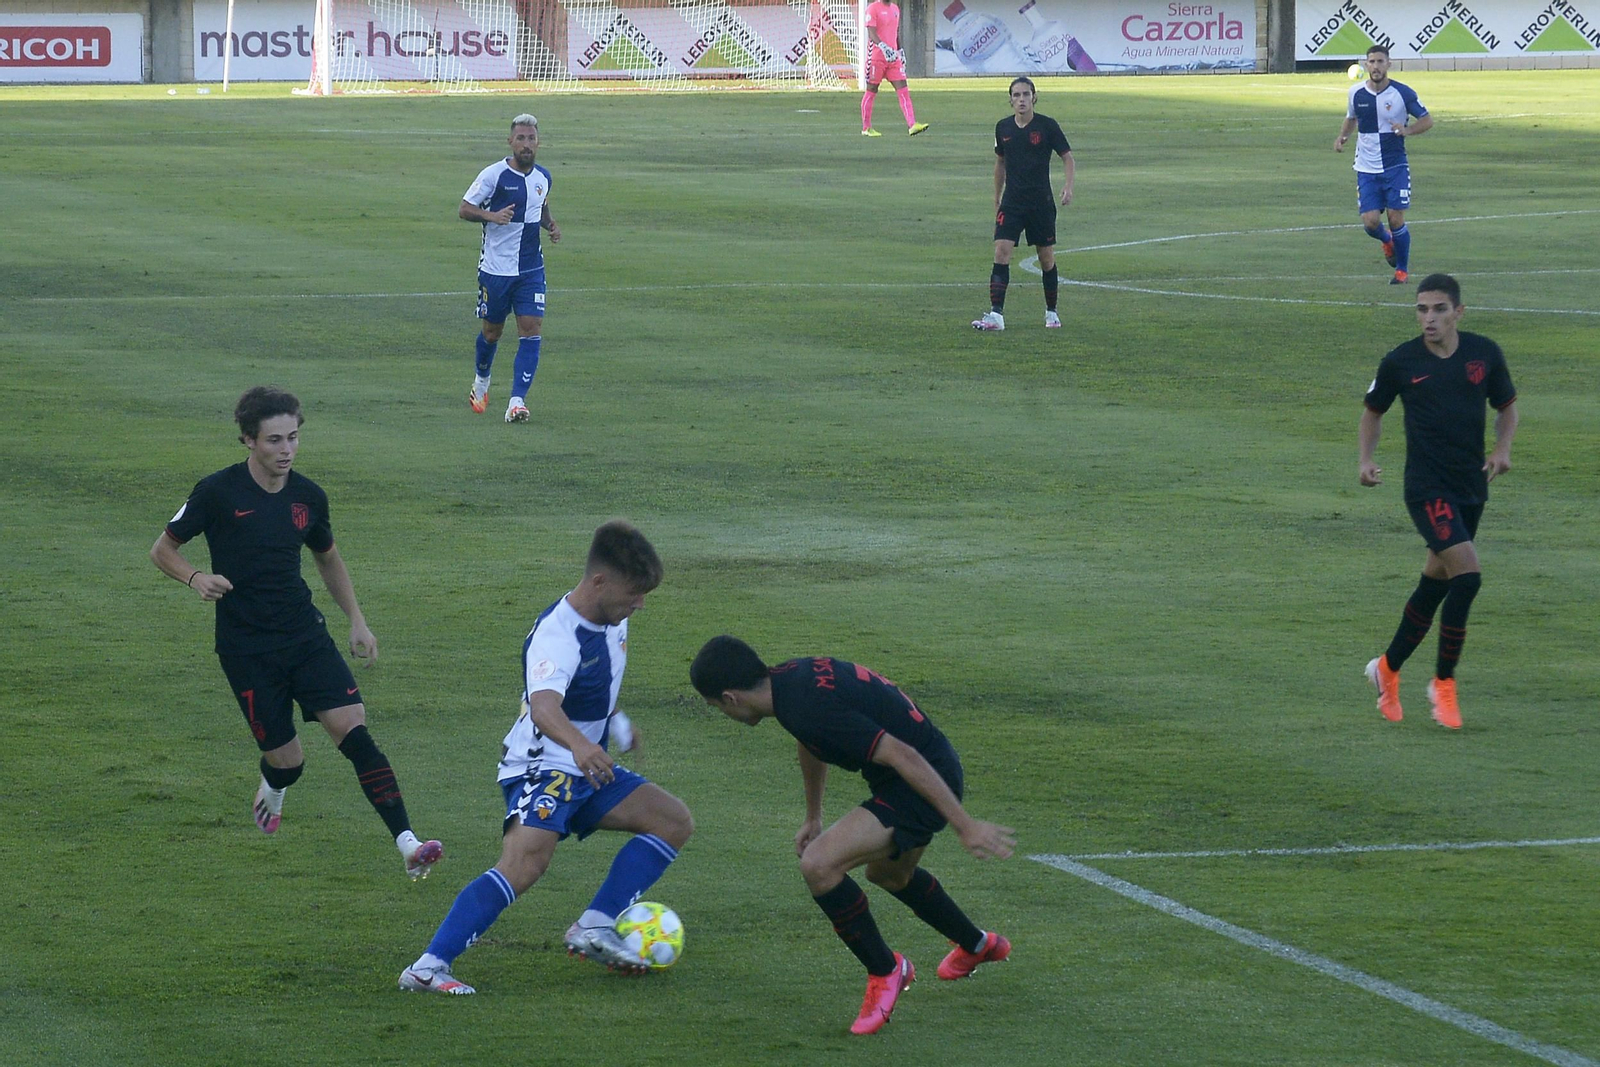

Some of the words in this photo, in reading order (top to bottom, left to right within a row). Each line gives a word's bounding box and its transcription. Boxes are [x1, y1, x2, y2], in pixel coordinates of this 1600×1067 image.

[1168, 3, 1213, 16] Sierra
[1514, 5, 1556, 50] LEROY
[1552, 0, 1600, 48] MERLIN
[962, 25, 998, 58] Cazorla
[1121, 12, 1243, 42] Cazorla
[1305, 9, 1346, 54] LEROY
[1342, 0, 1395, 51] MERLIN
[1409, 6, 1450, 52] LEROY
[1446, 0, 1501, 50] MERLIN
[0, 38, 99, 60] RICOH
[1121, 46, 1152, 59] Agua
[1155, 46, 1198, 57] Mineral
[1201, 45, 1244, 56] Natural
[1425, 498, 1454, 527] 14
[544, 770, 573, 802] 21
